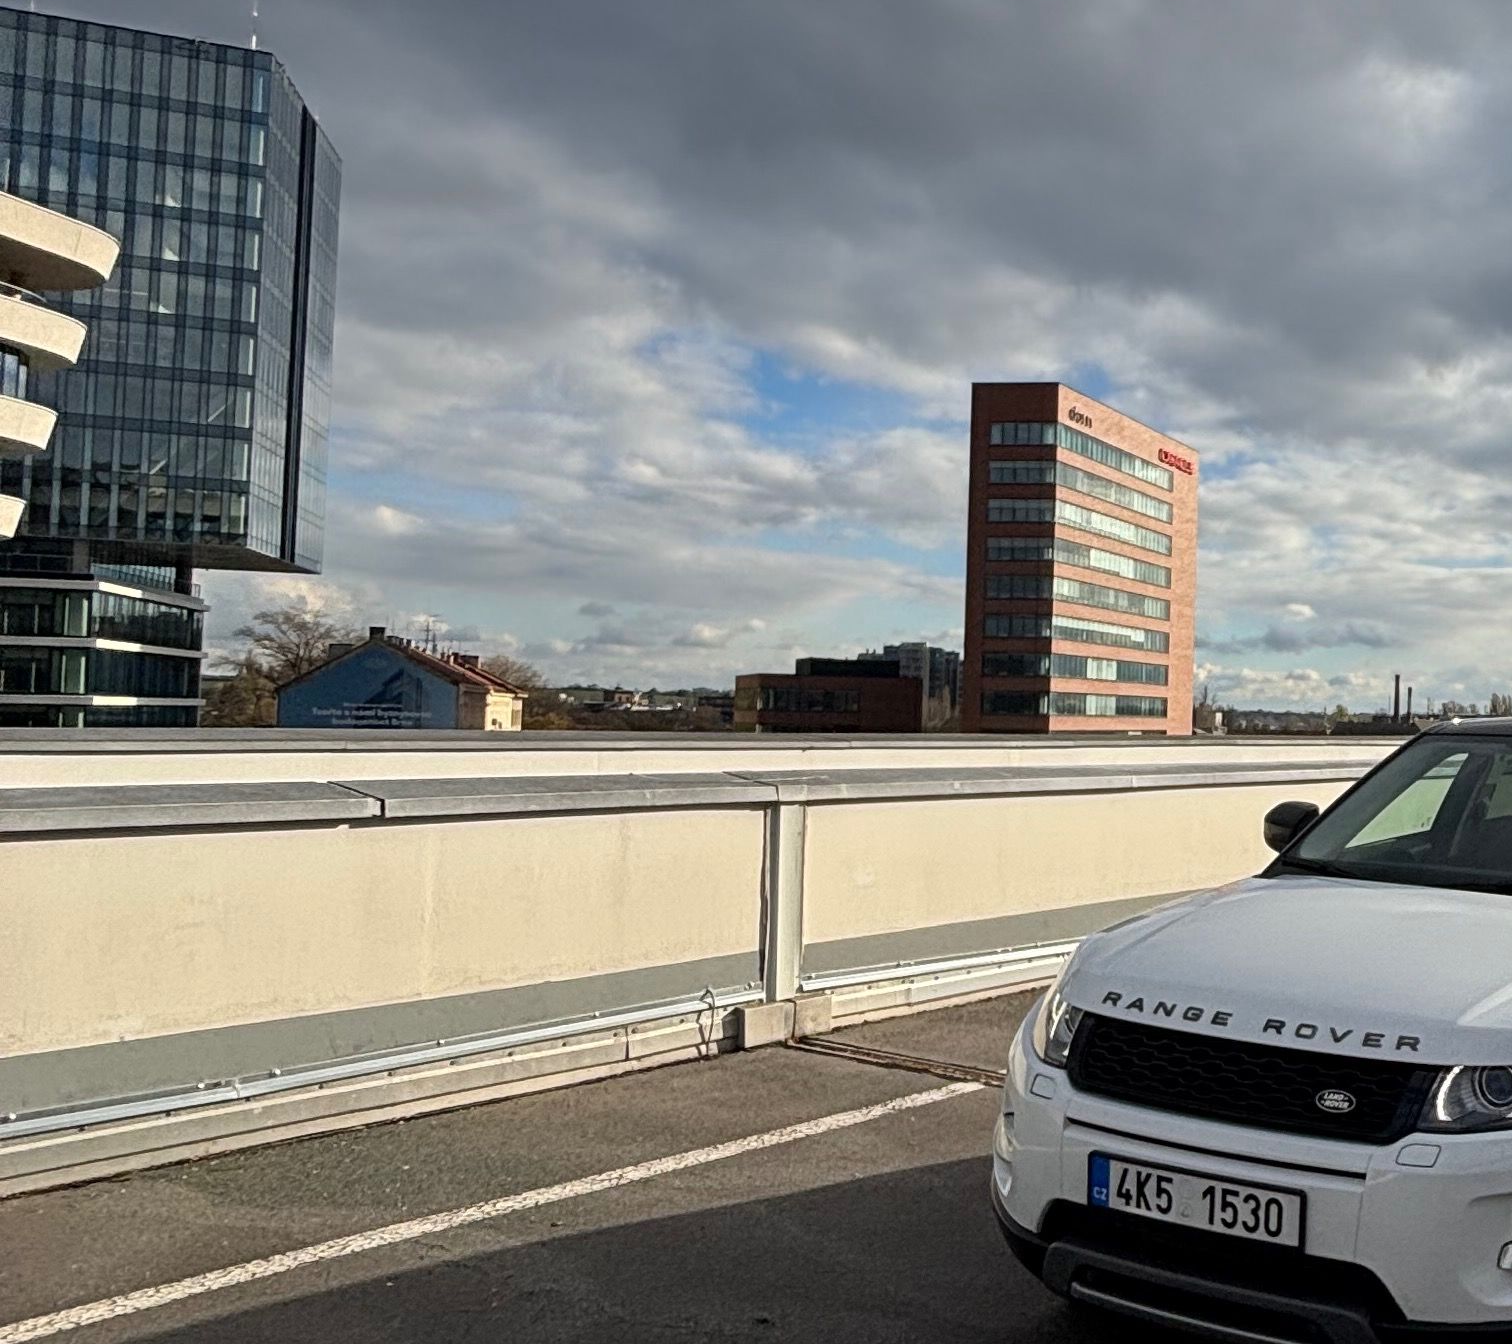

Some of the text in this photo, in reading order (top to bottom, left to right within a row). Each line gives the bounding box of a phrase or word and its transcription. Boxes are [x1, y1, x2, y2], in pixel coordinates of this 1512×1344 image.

[1101, 991, 1421, 1052] RANGE ROVER
[1093, 1186, 1107, 1201] CZ
[1116, 1167, 1283, 1238] 4K5 1530
